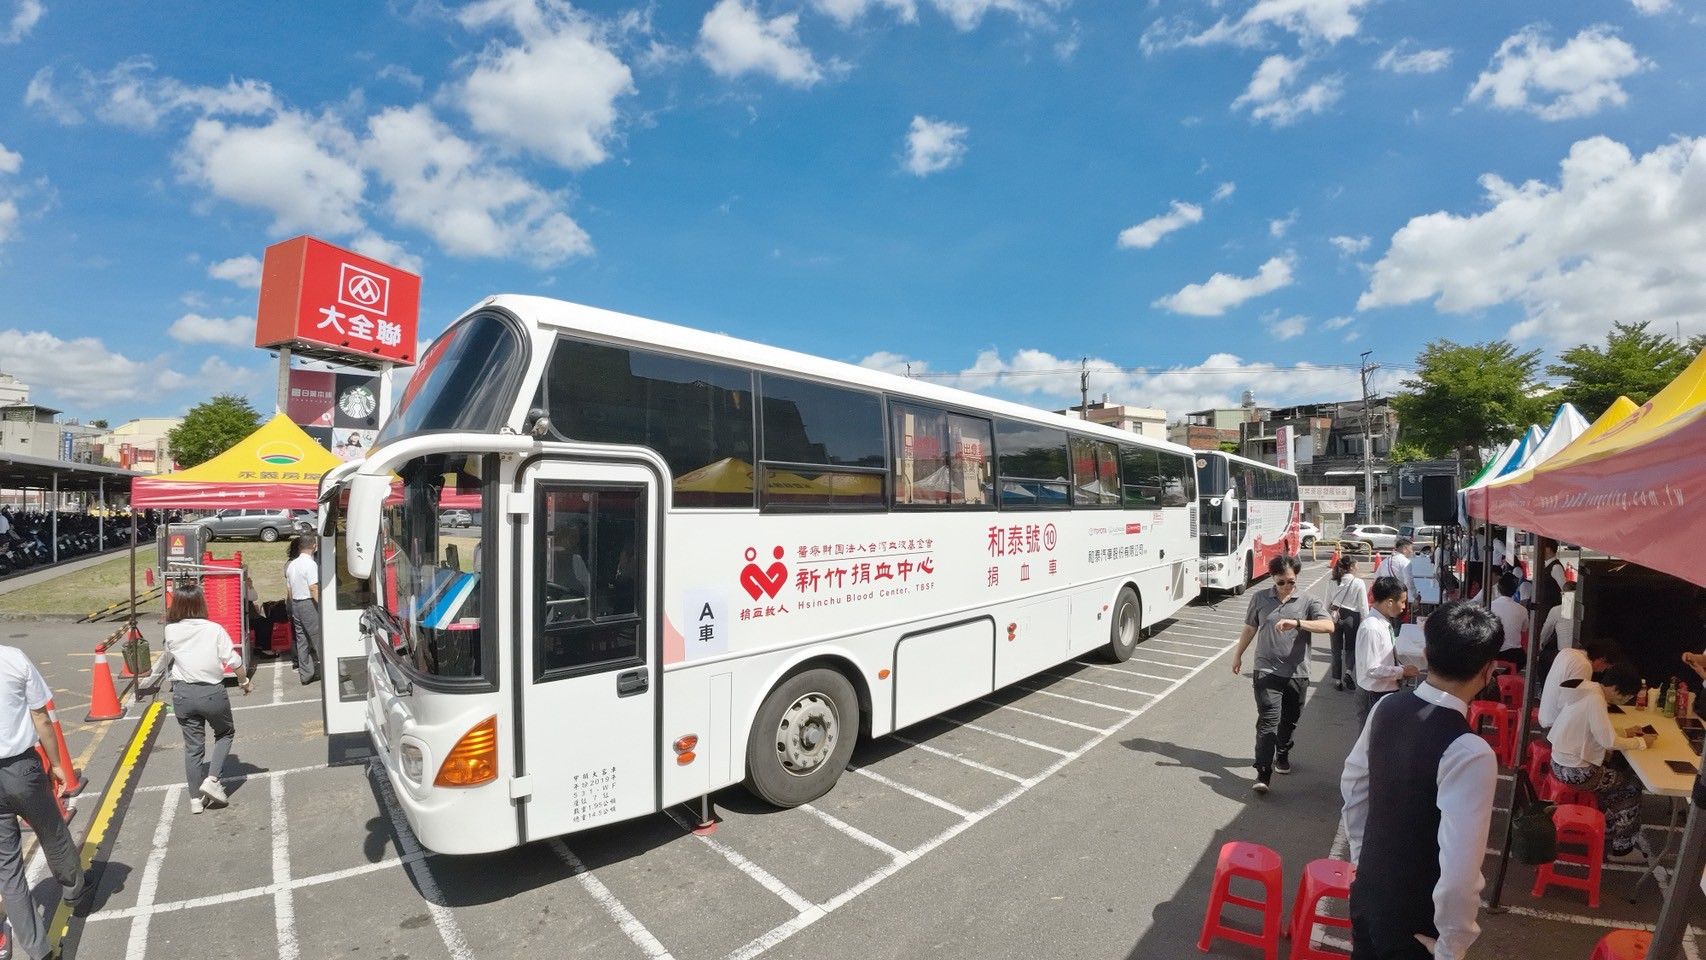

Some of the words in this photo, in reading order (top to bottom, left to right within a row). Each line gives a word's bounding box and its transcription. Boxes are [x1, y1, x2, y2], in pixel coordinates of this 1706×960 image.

[316, 304, 402, 347] 大全聯
[988, 524, 1041, 558] 和泰號
[795, 556, 935, 593] 新竹捐血中心
[988, 559, 1057, 588] 捐血車
[798, 596, 841, 610] Hsinchu
[846, 591, 874, 603] Blood
[879, 585, 911, 598] Center,
[915, 582, 935, 592] TBSF
